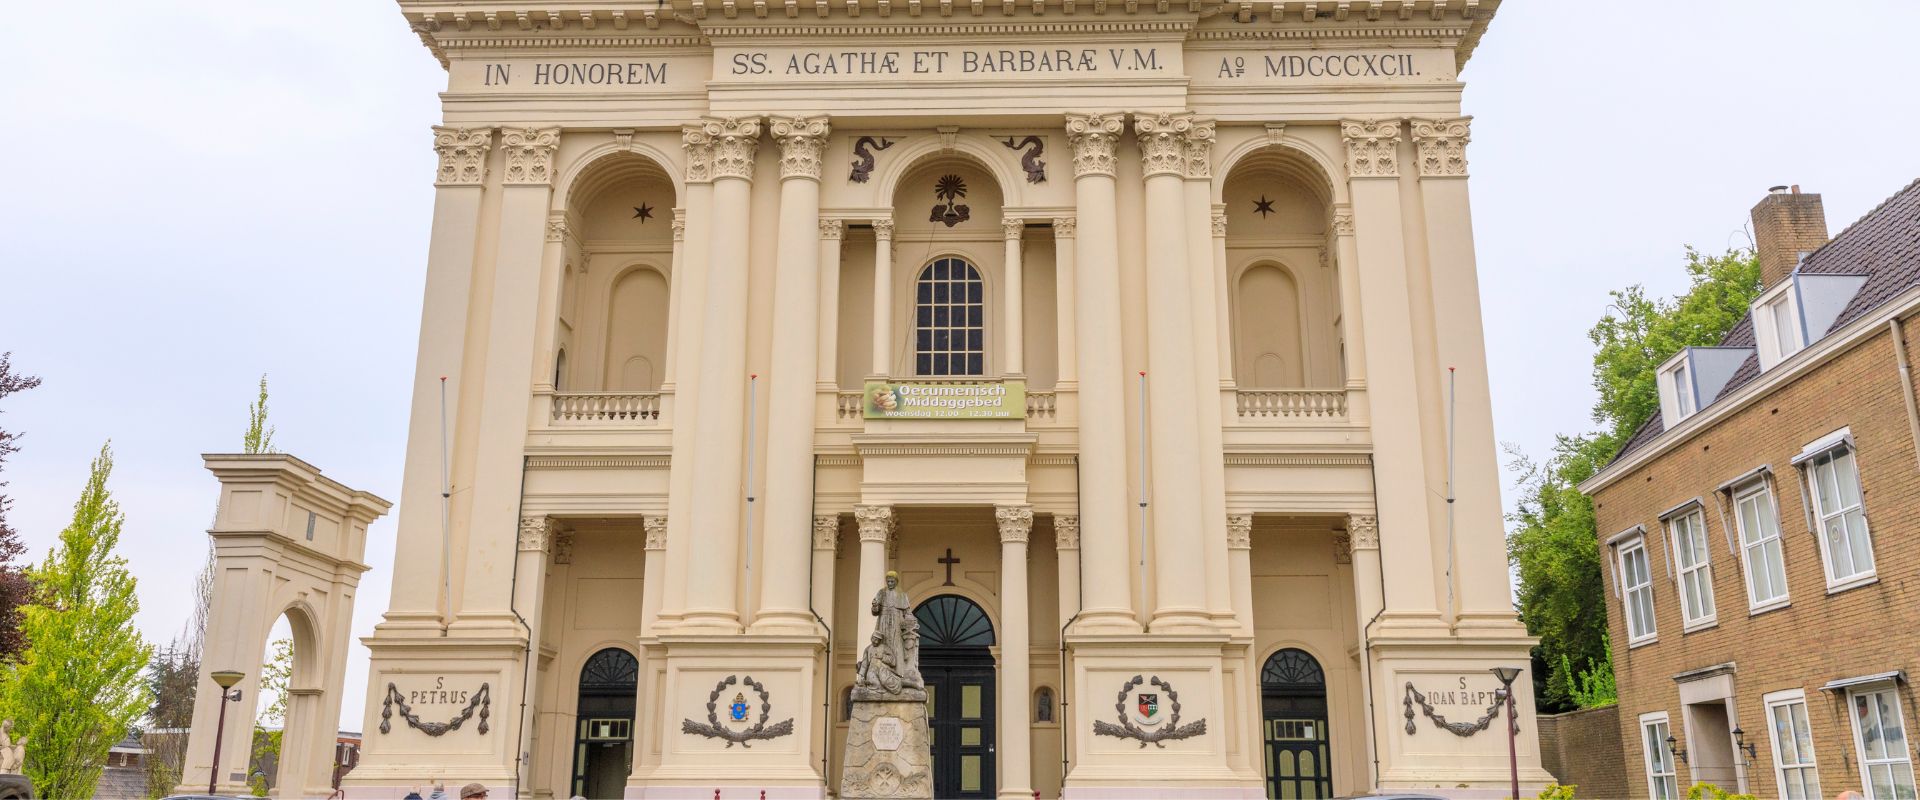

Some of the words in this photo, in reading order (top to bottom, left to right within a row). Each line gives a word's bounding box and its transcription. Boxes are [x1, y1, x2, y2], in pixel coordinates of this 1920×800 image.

[732, 53, 773, 75] SS.
[785, 51, 900, 75] AGATHÆ
[912, 51, 949, 74] ET
[962, 49, 1097, 73] BARBARÆ
[1264, 54, 1421, 78] MDCCCXCII.
[484, 64, 511, 86] IN
[534, 62, 668, 85] HONOREM
[899, 384, 1006, 397] Oecumenisch
[903, 396, 1002, 409] Middaggebed
[885, 409, 931, 418] woensdag
[436, 676, 444, 690] S
[1459, 676, 1467, 690] S
[410, 690, 468, 705] PETRUS
[1427, 691, 1456, 705] IOAN
